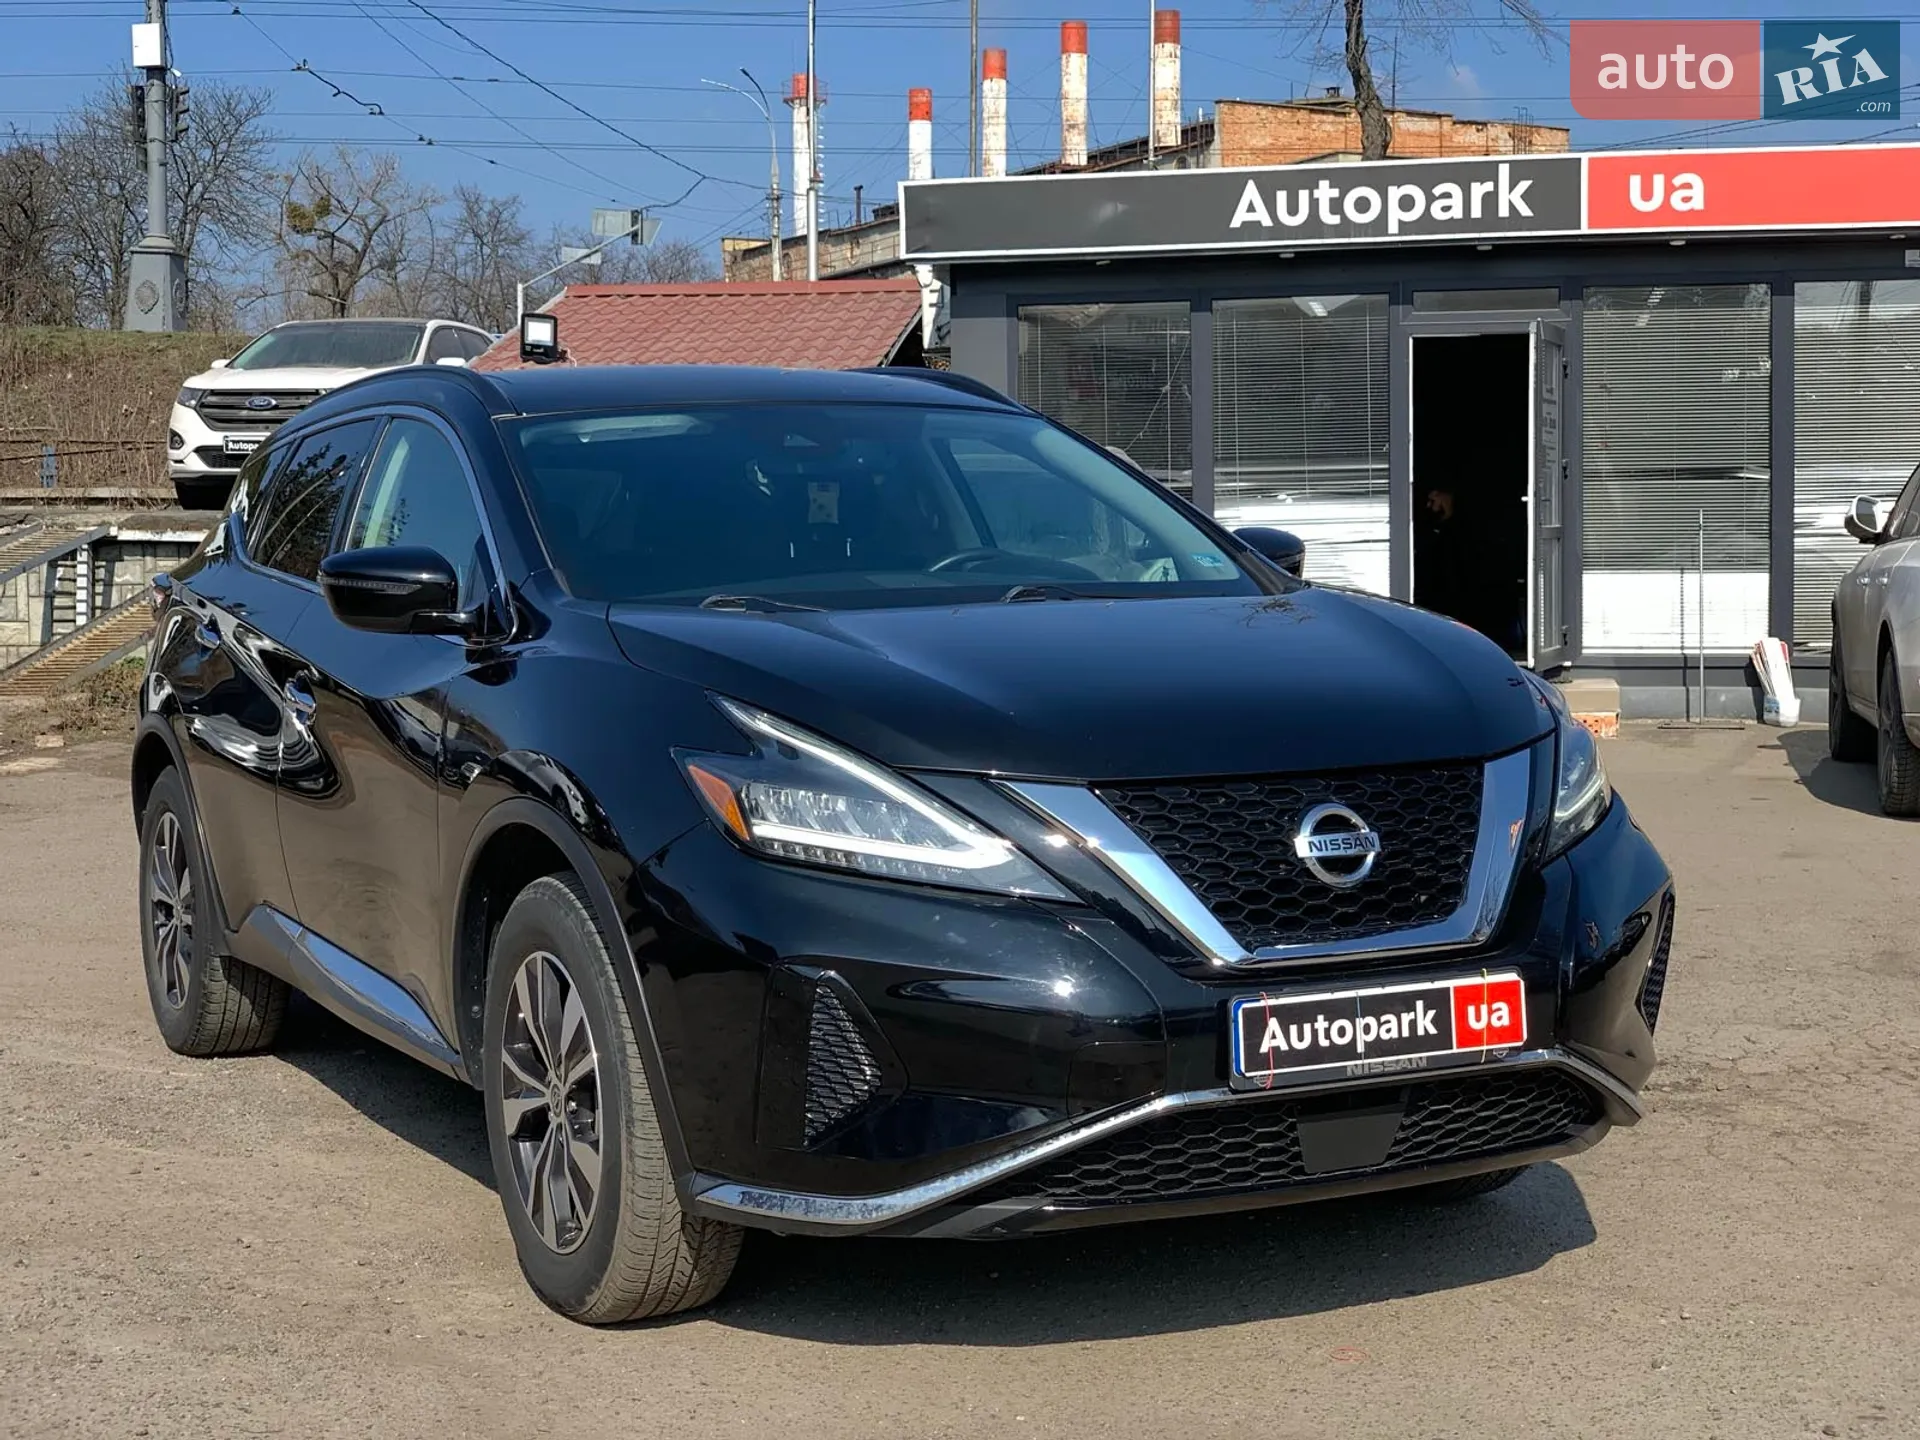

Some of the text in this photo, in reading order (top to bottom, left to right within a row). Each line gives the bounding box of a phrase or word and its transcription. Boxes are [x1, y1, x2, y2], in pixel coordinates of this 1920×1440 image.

[1229, 163, 1705, 234] Autopark ua
[1308, 837, 1376, 853] NISSAN
[1259, 999, 1511, 1053] Autopark ua
[1346, 1056, 1427, 1077] NISSAN
